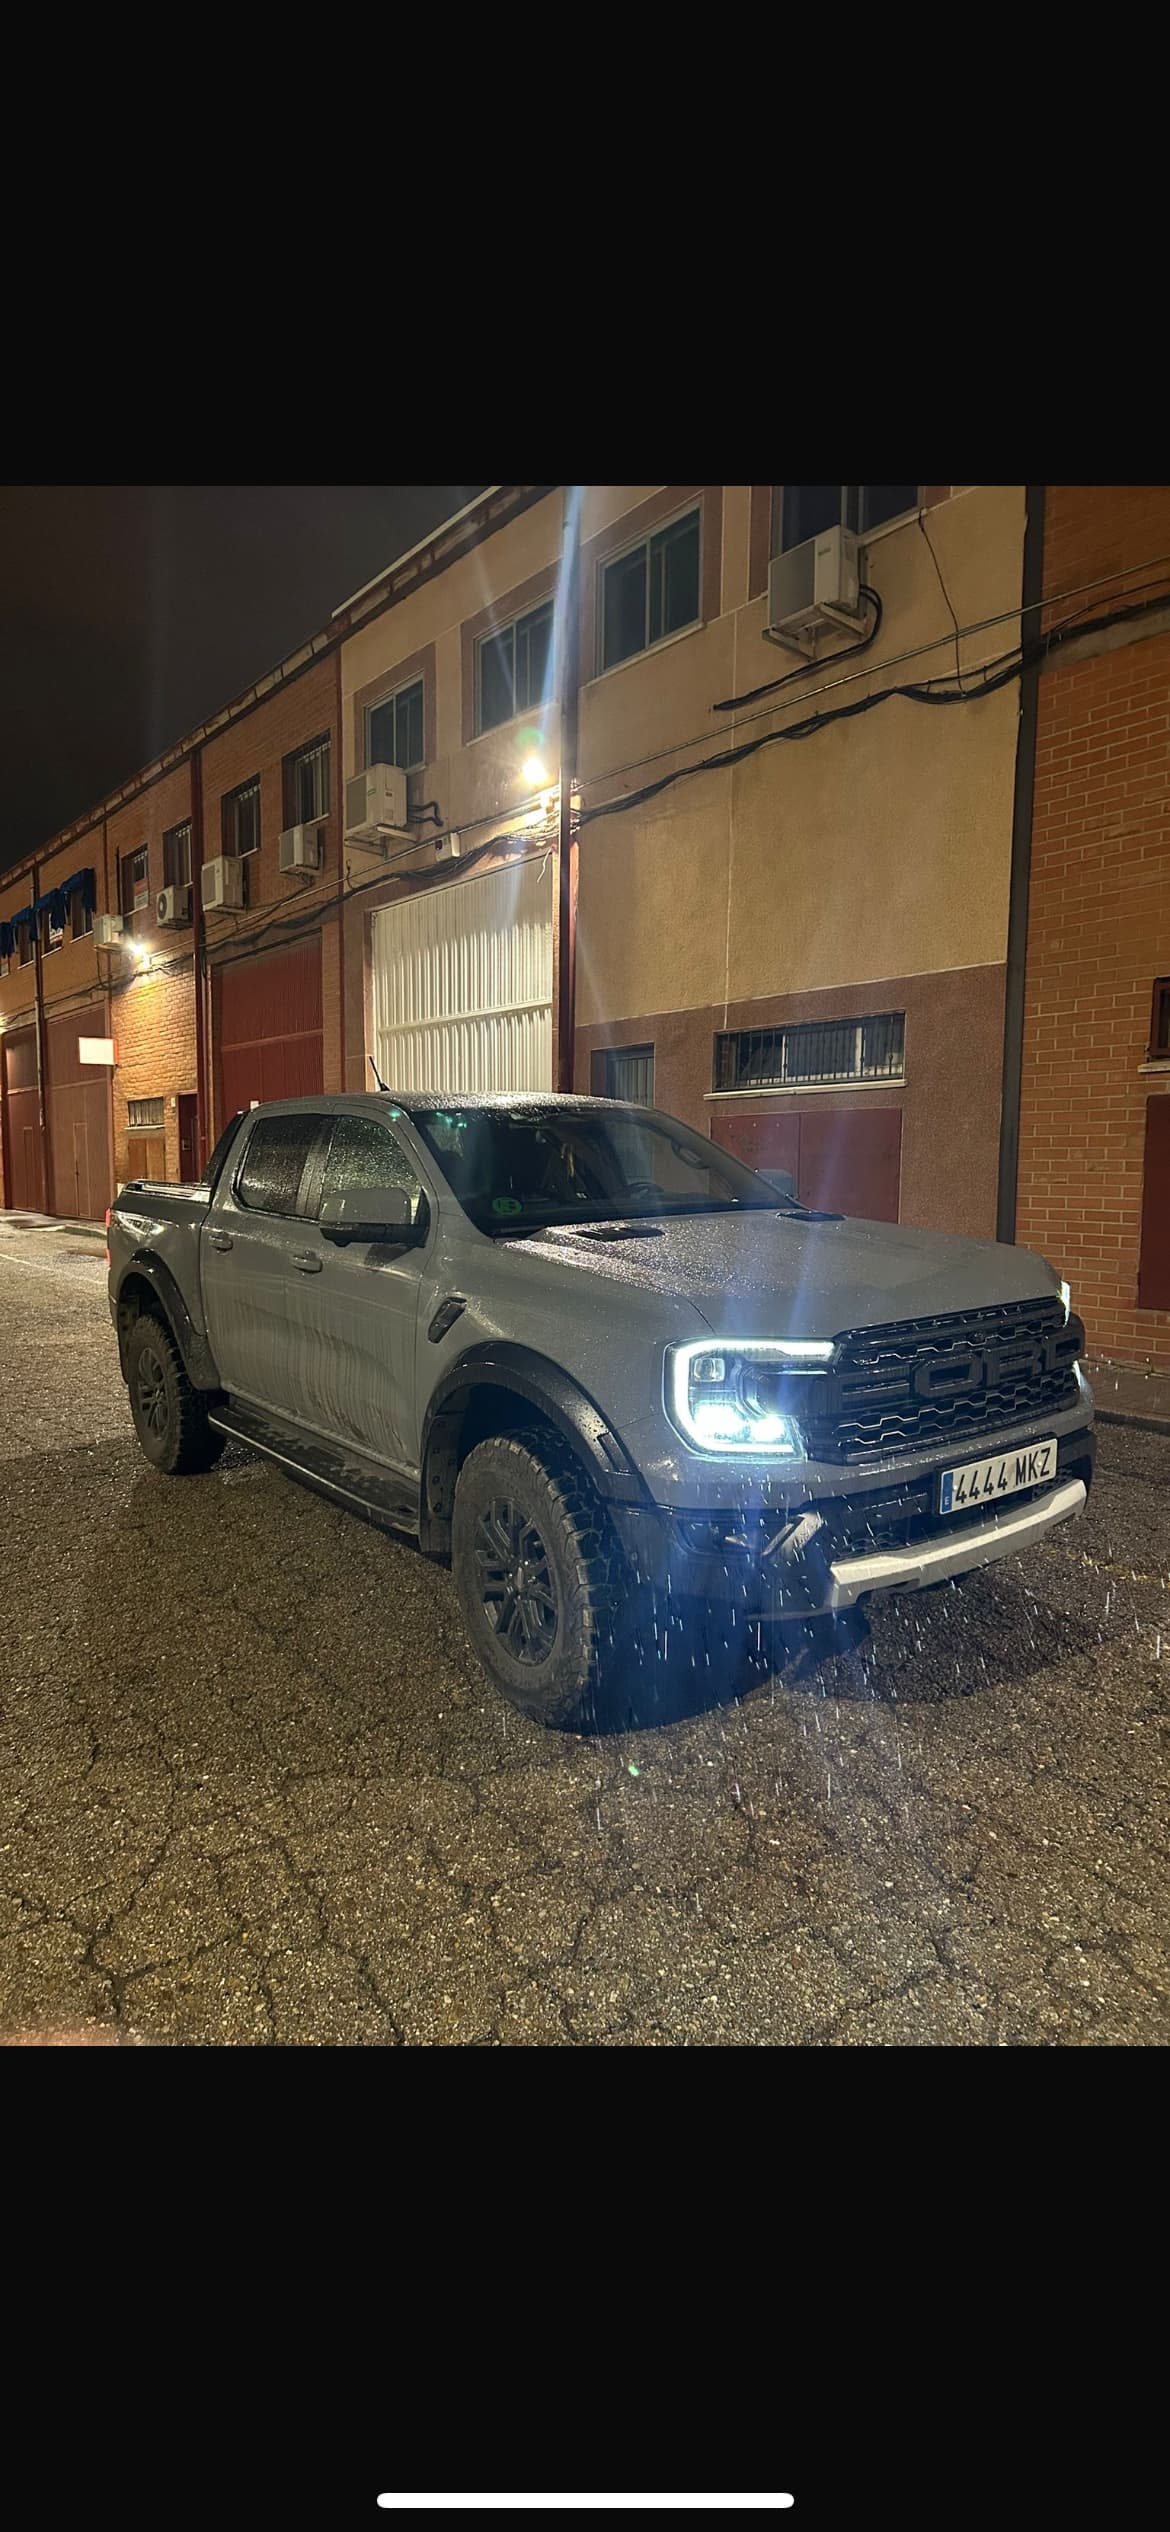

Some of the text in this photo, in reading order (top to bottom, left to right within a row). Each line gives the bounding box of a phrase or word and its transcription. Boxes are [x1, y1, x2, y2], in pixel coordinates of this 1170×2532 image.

[818, 1319, 1084, 1415] FORD
[944, 1496, 950, 1505] E
[955, 1447, 1051, 1504] 4444 MKZ
